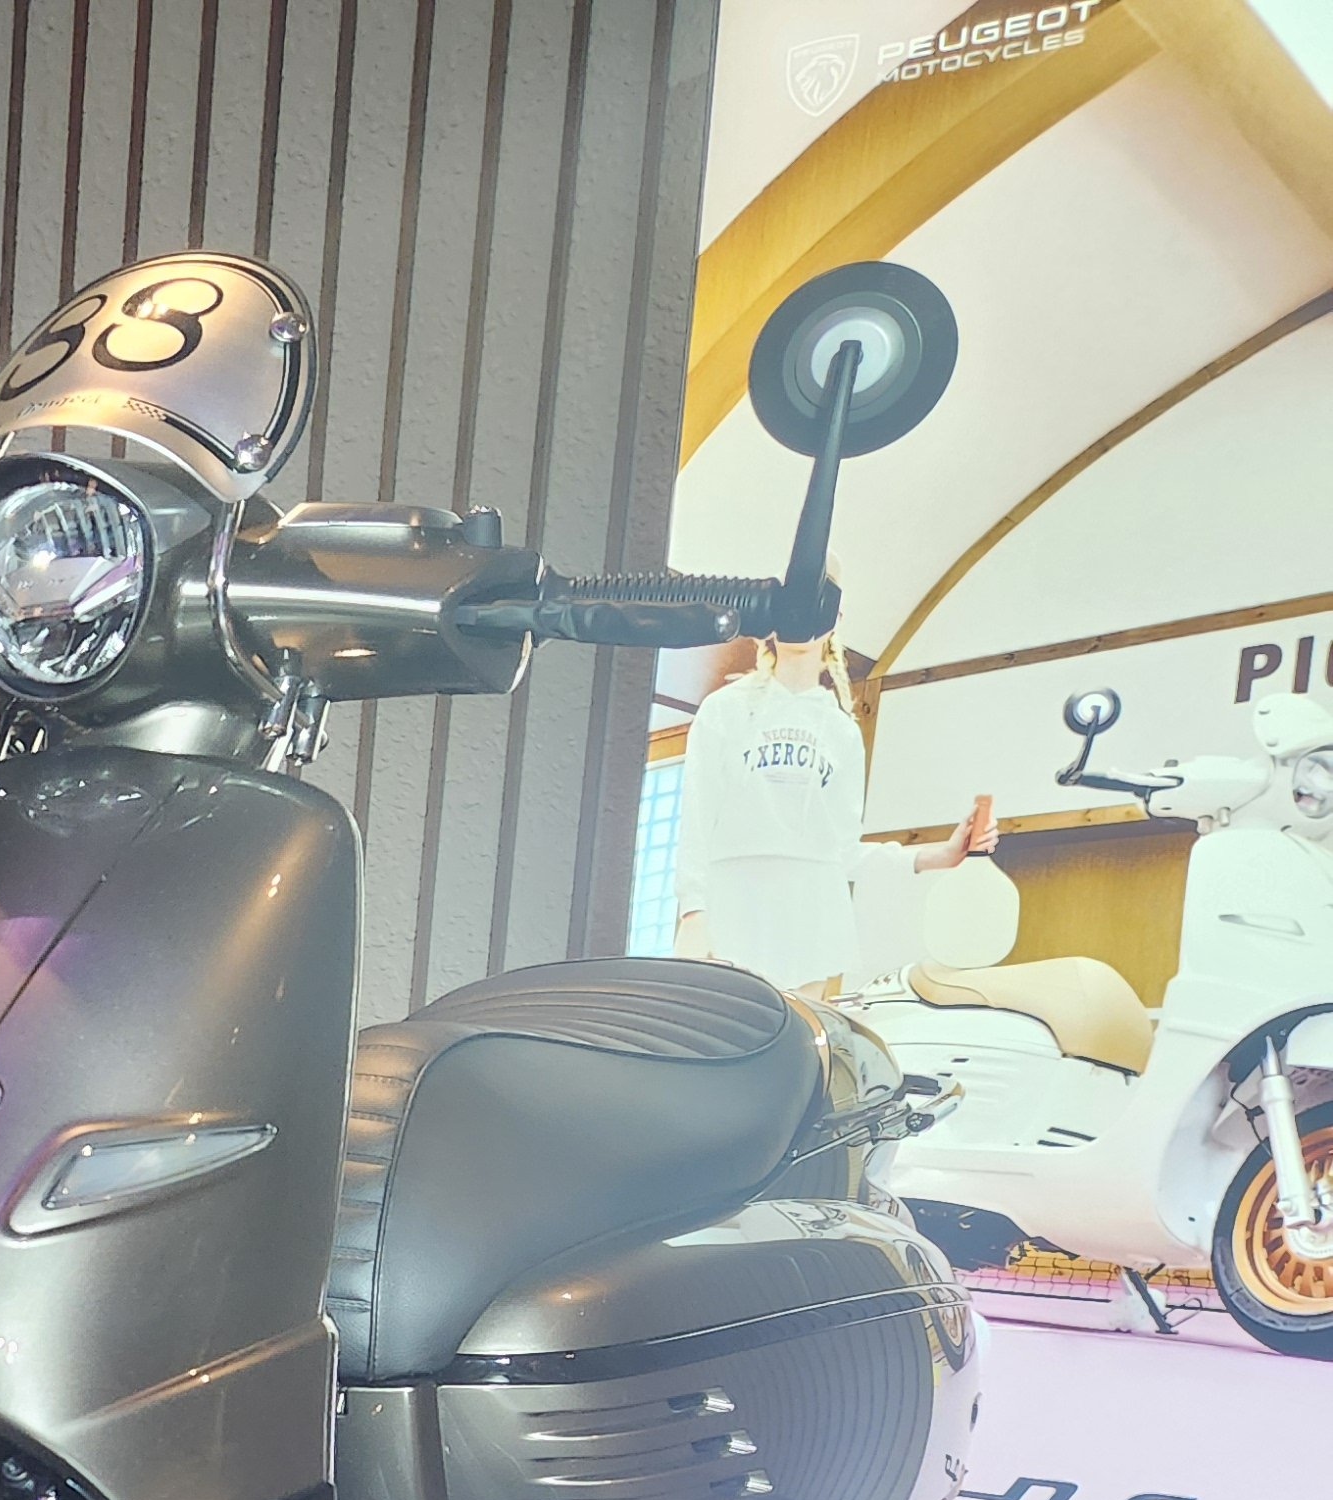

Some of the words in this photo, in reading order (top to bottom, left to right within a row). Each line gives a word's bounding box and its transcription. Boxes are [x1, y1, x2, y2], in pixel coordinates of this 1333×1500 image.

[877, 28, 1086, 83] MOTOCYCLES
[878, 0, 1101, 65] PEUGEOT
[1234, 635, 1333, 704] PI
